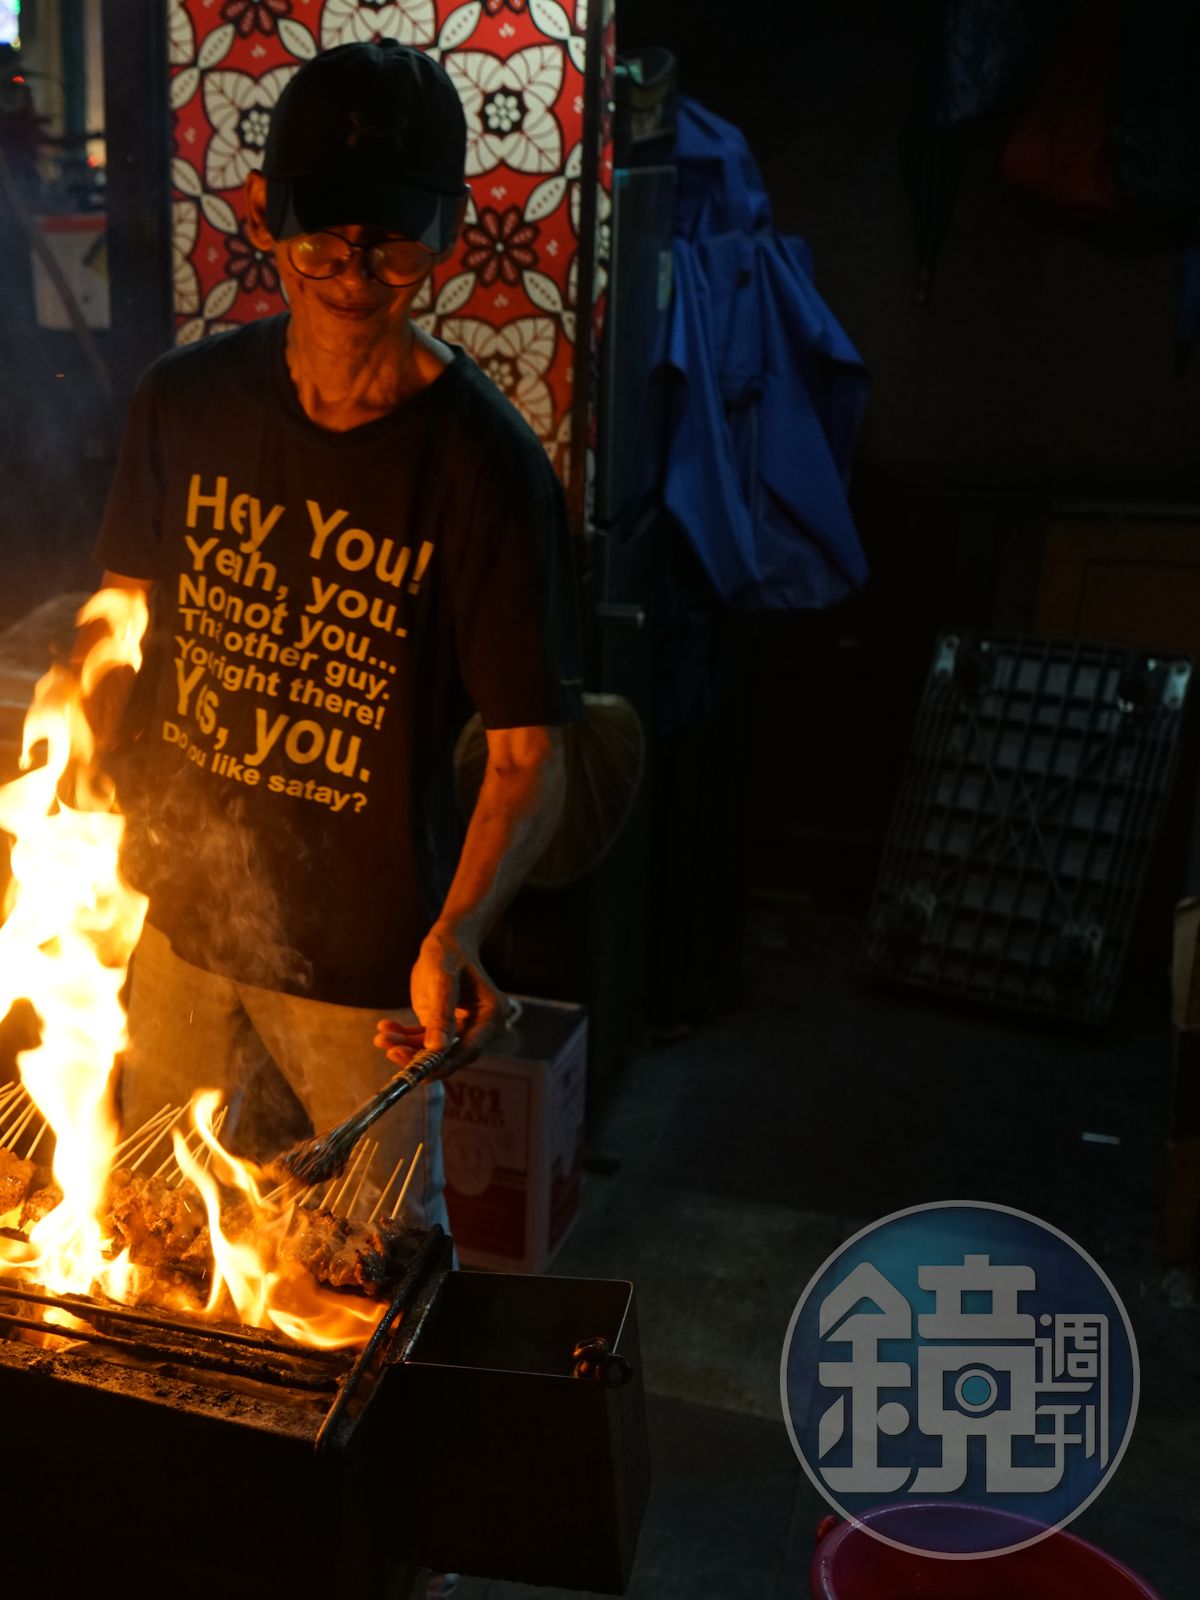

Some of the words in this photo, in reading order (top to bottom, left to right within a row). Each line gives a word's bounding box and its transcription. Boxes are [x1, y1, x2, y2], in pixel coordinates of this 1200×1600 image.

[185, 473, 286, 554] Hey
[306, 499, 435, 596] You!
[305, 576, 408, 639] you.
[223, 631, 319, 672] other
[325, 660, 390, 701] guy.
[293, 614, 397, 675] you...
[288, 678, 386, 731] there!
[244, 707, 371, 783] you.
[211, 753, 261, 786] like
[267, 774, 368, 814] satay?
